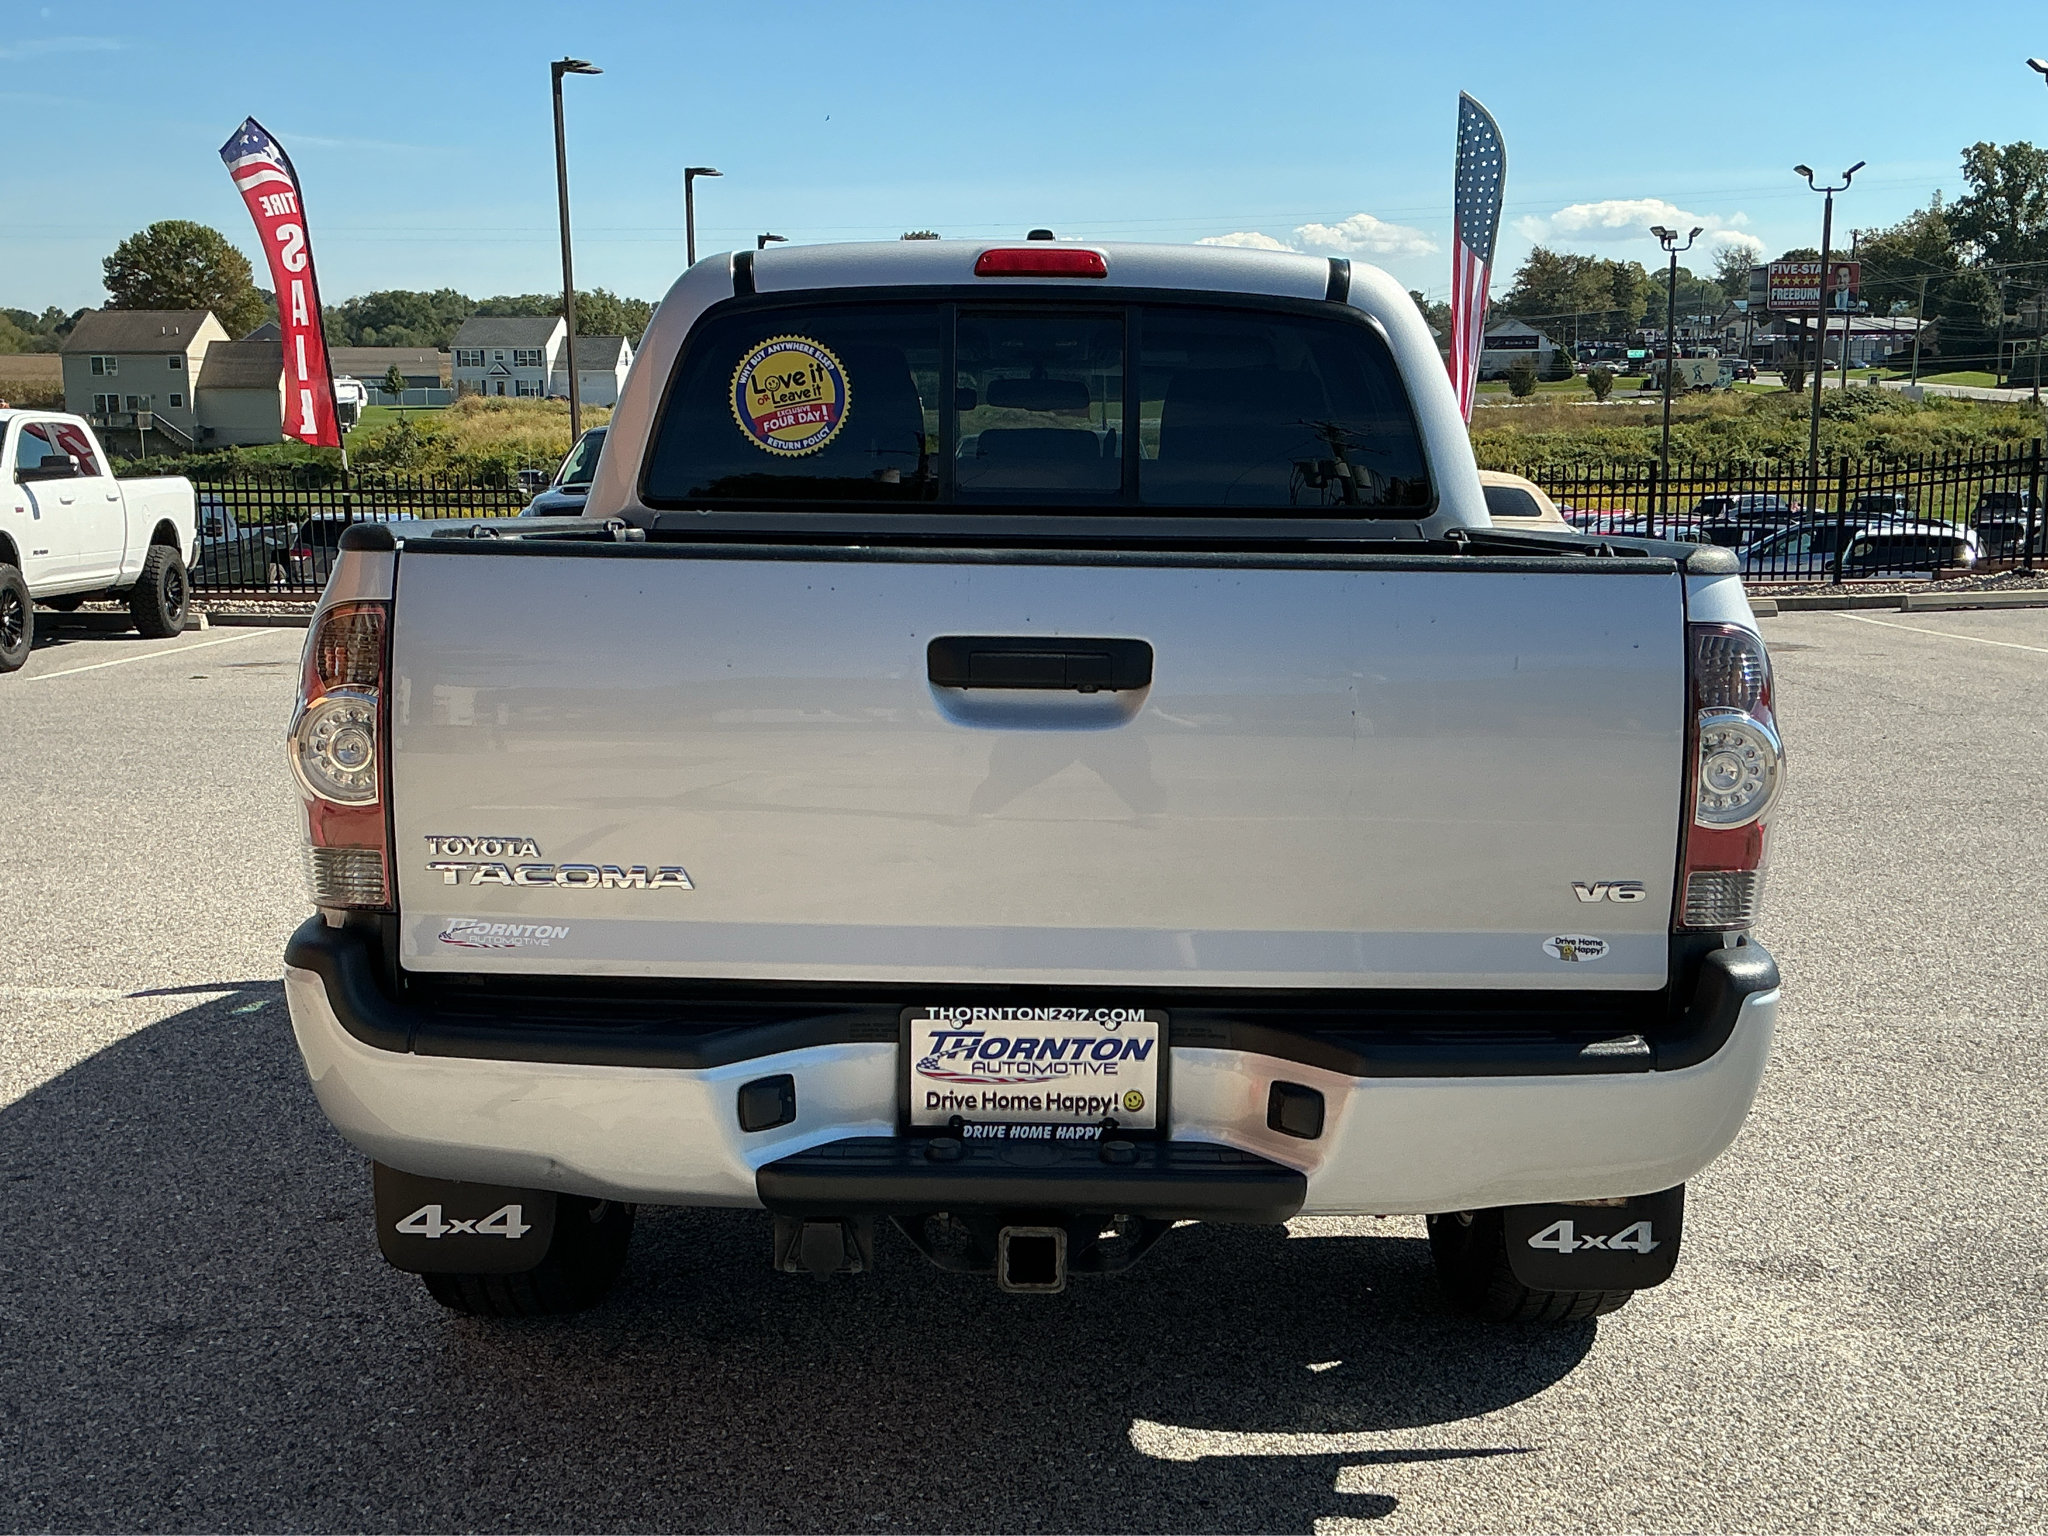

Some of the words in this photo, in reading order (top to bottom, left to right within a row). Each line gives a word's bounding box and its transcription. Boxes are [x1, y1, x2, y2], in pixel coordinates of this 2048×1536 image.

[1771, 287, 1820, 300] FREEBURN
[739, 364, 753, 384] WHY
[751, 351, 766, 366] BUY
[768, 342, 814, 355] ANYWHERE
[814, 352, 835, 371] ELSE?
[751, 370, 806, 394] Love
[808, 362, 824, 383] it
[757, 394, 771, 405] OR
[771, 387, 811, 404] Leave
[813, 384, 822, 396] it
[777, 405, 811, 417] EXCLUSIVE
[763, 414, 795, 432] FOUR
[767, 436, 802, 450] RETURN
[803, 426, 831, 447] POLICY
[424, 836, 541, 858] TOYOTA
[425, 862, 695, 891] TACOMA
[1571, 880, 1646, 903] V6
[444, 917, 570, 939] THORNTON
[468, 935, 551, 947] AUTOMOTIVE
[1555, 937, 1576, 945] Drive
[1578, 938, 1603, 946] Home
[926, 1007, 1145, 1022] THORNTON247.COM
[928, 1030, 1155, 1061] THORNTON
[971, 1060, 1118, 1075] AUTOMOTIVE
[926, 1090, 978, 1110] Drive
[982, 1091, 1042, 1111] Home
[1047, 1092, 1119, 1116] Happy!
[963, 1124, 1005, 1139] DRIVE
[1009, 1125, 1052, 1139] HOME
[1056, 1126, 1103, 1140] HAPPY
[395, 1204, 531, 1239] 4x4
[1528, 1220, 1661, 1254] 4x4
